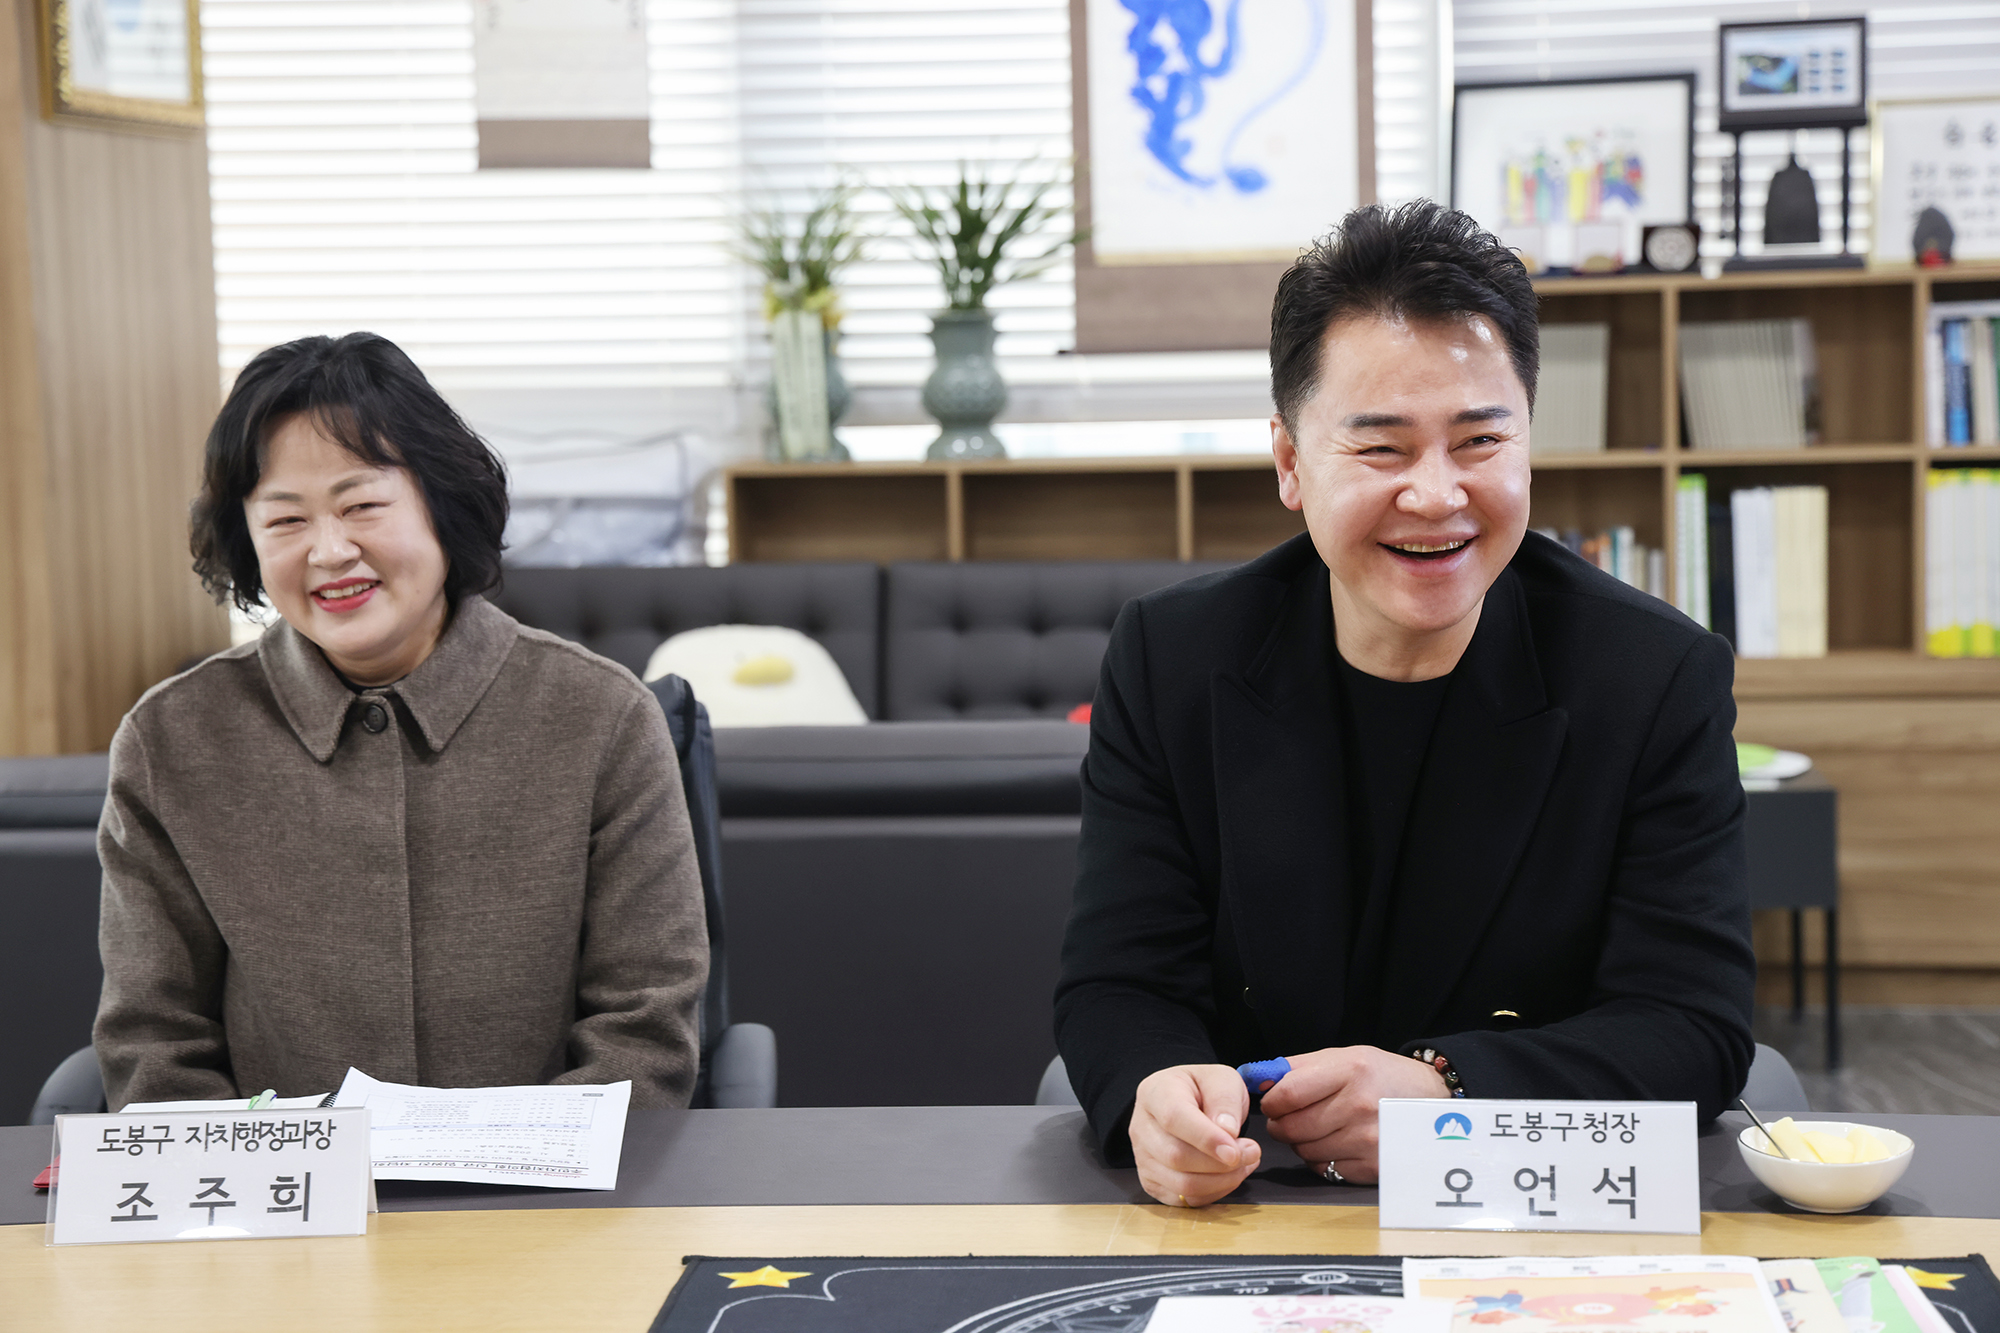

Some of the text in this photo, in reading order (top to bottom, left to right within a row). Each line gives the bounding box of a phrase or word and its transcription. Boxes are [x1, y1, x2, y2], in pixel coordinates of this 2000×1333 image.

[97, 1119, 337, 1156] 도봉구 자치행정과장
[1490, 1112, 1640, 1144] 도봉구청장
